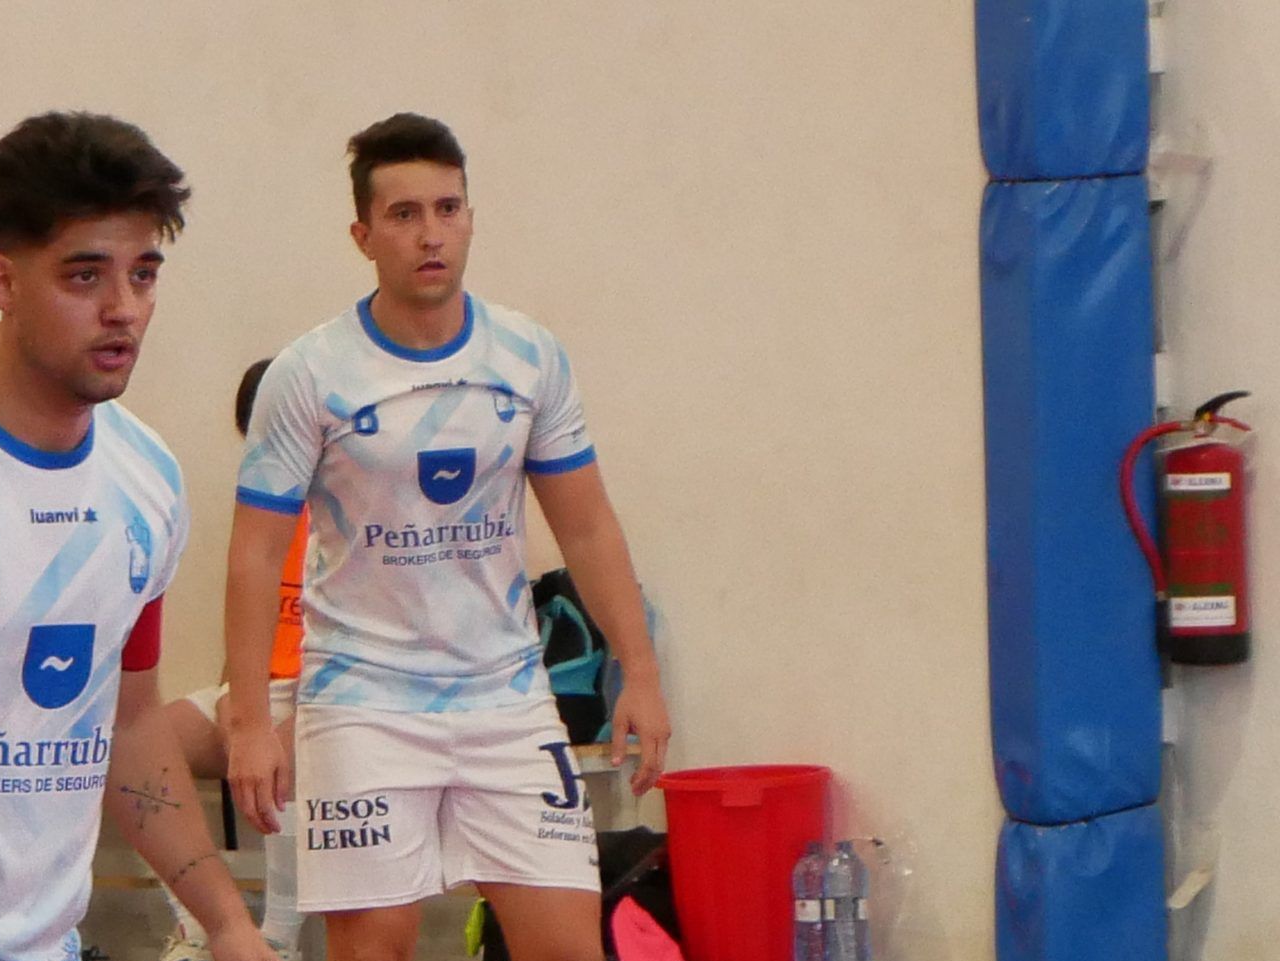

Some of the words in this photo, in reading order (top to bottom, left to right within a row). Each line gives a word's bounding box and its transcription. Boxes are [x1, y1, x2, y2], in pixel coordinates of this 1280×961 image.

[30, 507, 79, 524] luanvi
[382, 553, 437, 566] BROKERS
[438, 550, 453, 561] DE
[35, 778, 51, 792] DE
[306, 795, 389, 821] YESOS
[308, 820, 391, 850] LERÍN
